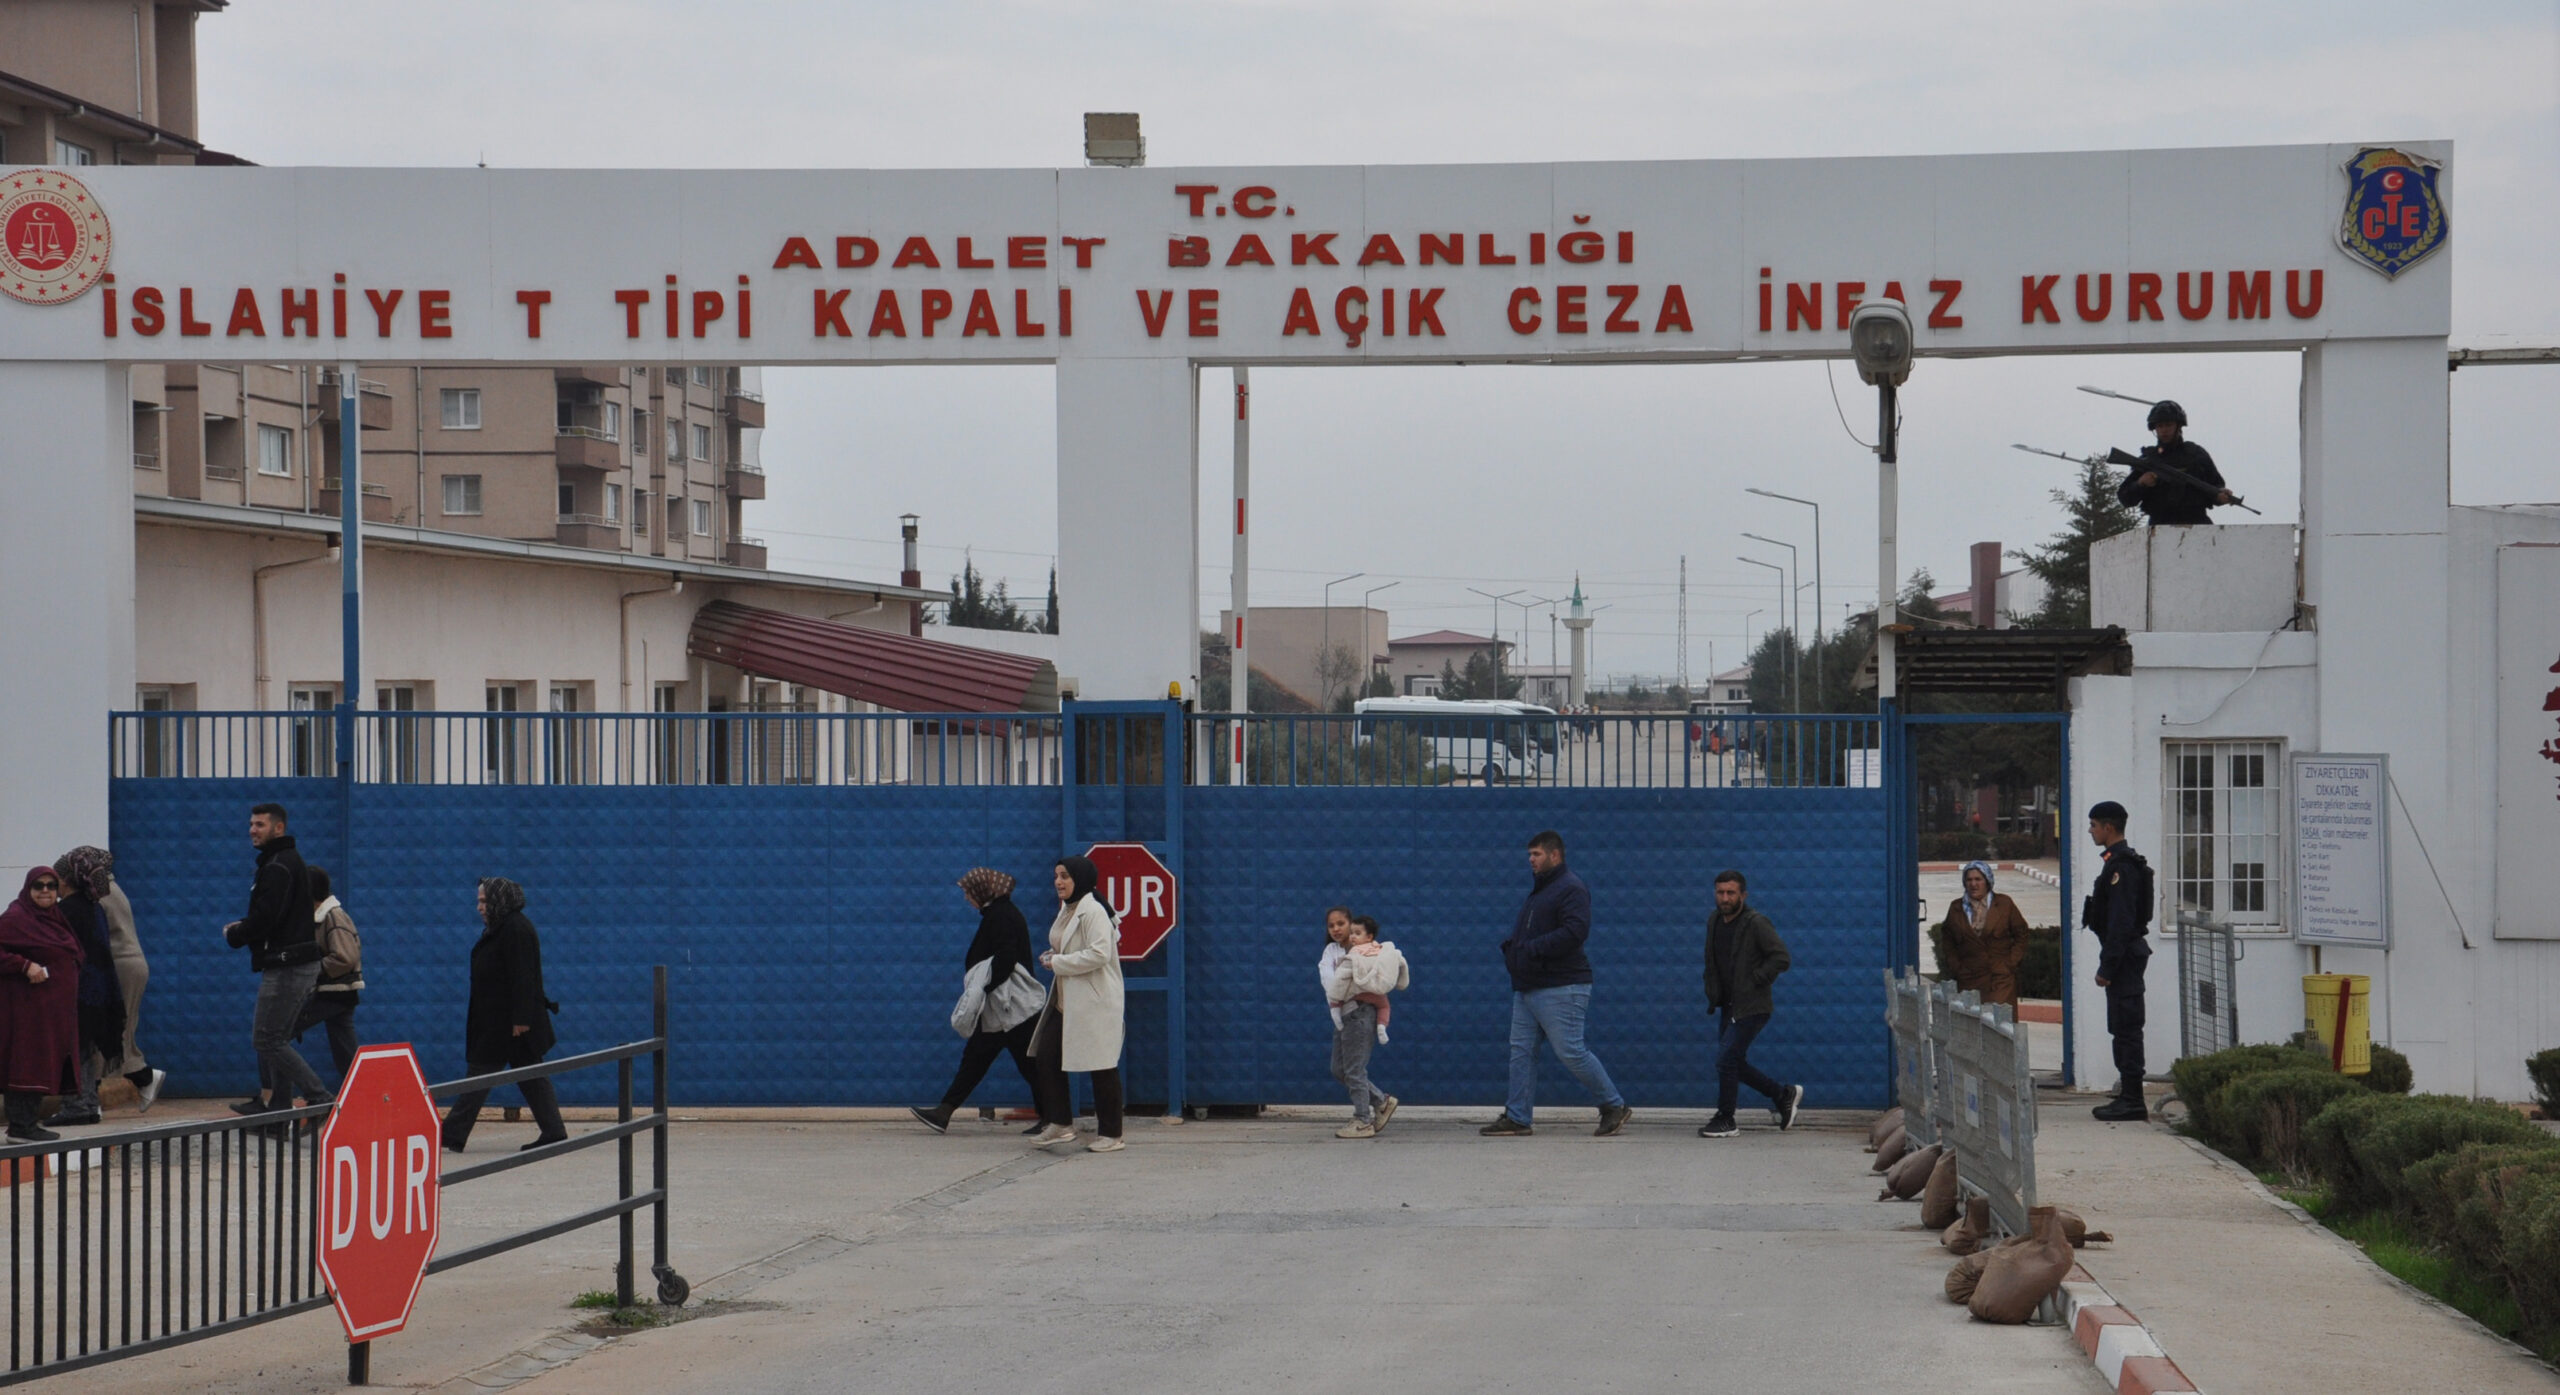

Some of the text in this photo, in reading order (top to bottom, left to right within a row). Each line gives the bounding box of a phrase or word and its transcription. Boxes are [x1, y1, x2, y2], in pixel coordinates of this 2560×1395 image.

[49, 196, 80, 222] ADALET
[1175, 185, 1296, 218] T.C.
[64, 224, 85, 272] BAKANLIĞI
[774, 215, 1634, 268] ADALET BAKANLIĞI
[103, 273, 453, 337] İSLAHİYE
[517, 290, 552, 338] T
[615, 274, 752, 338] TİPİ
[814, 287, 1072, 337] KAPALI
[1137, 288, 1219, 337] VE
[1283, 285, 1446, 346] AÇIK
[1507, 284, 1695, 334] CEZA
[2023, 269, 2324, 323] KURUMU
[2305, 765, 2369, 781] ZİYARETÇİLERİN
[2315, 783, 2359, 797] DİKKATİNE
[1107, 875, 1165, 918] UR
[331, 1133, 430, 1250] DUR
